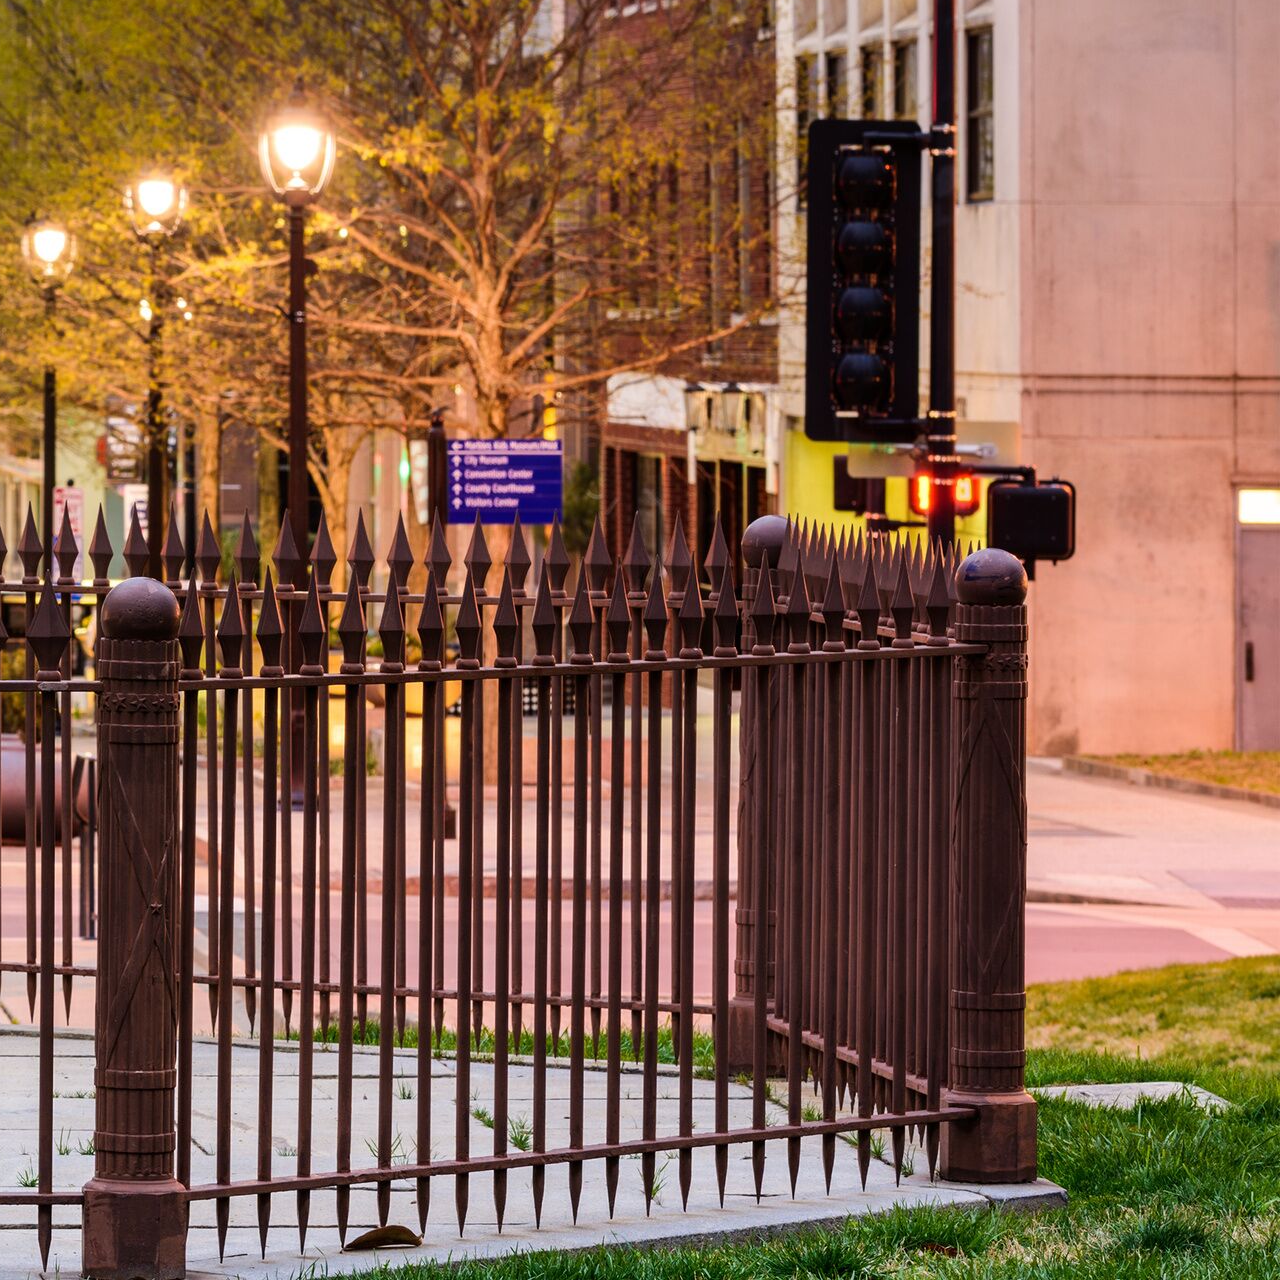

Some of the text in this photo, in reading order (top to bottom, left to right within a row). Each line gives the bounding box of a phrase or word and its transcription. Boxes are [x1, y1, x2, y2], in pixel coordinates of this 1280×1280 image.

[464, 455, 509, 467] City Museum
[464, 469, 534, 479] Convention Center
[464, 483, 535, 495] County Courthouse
[465, 497, 519, 508] Visitors Center
